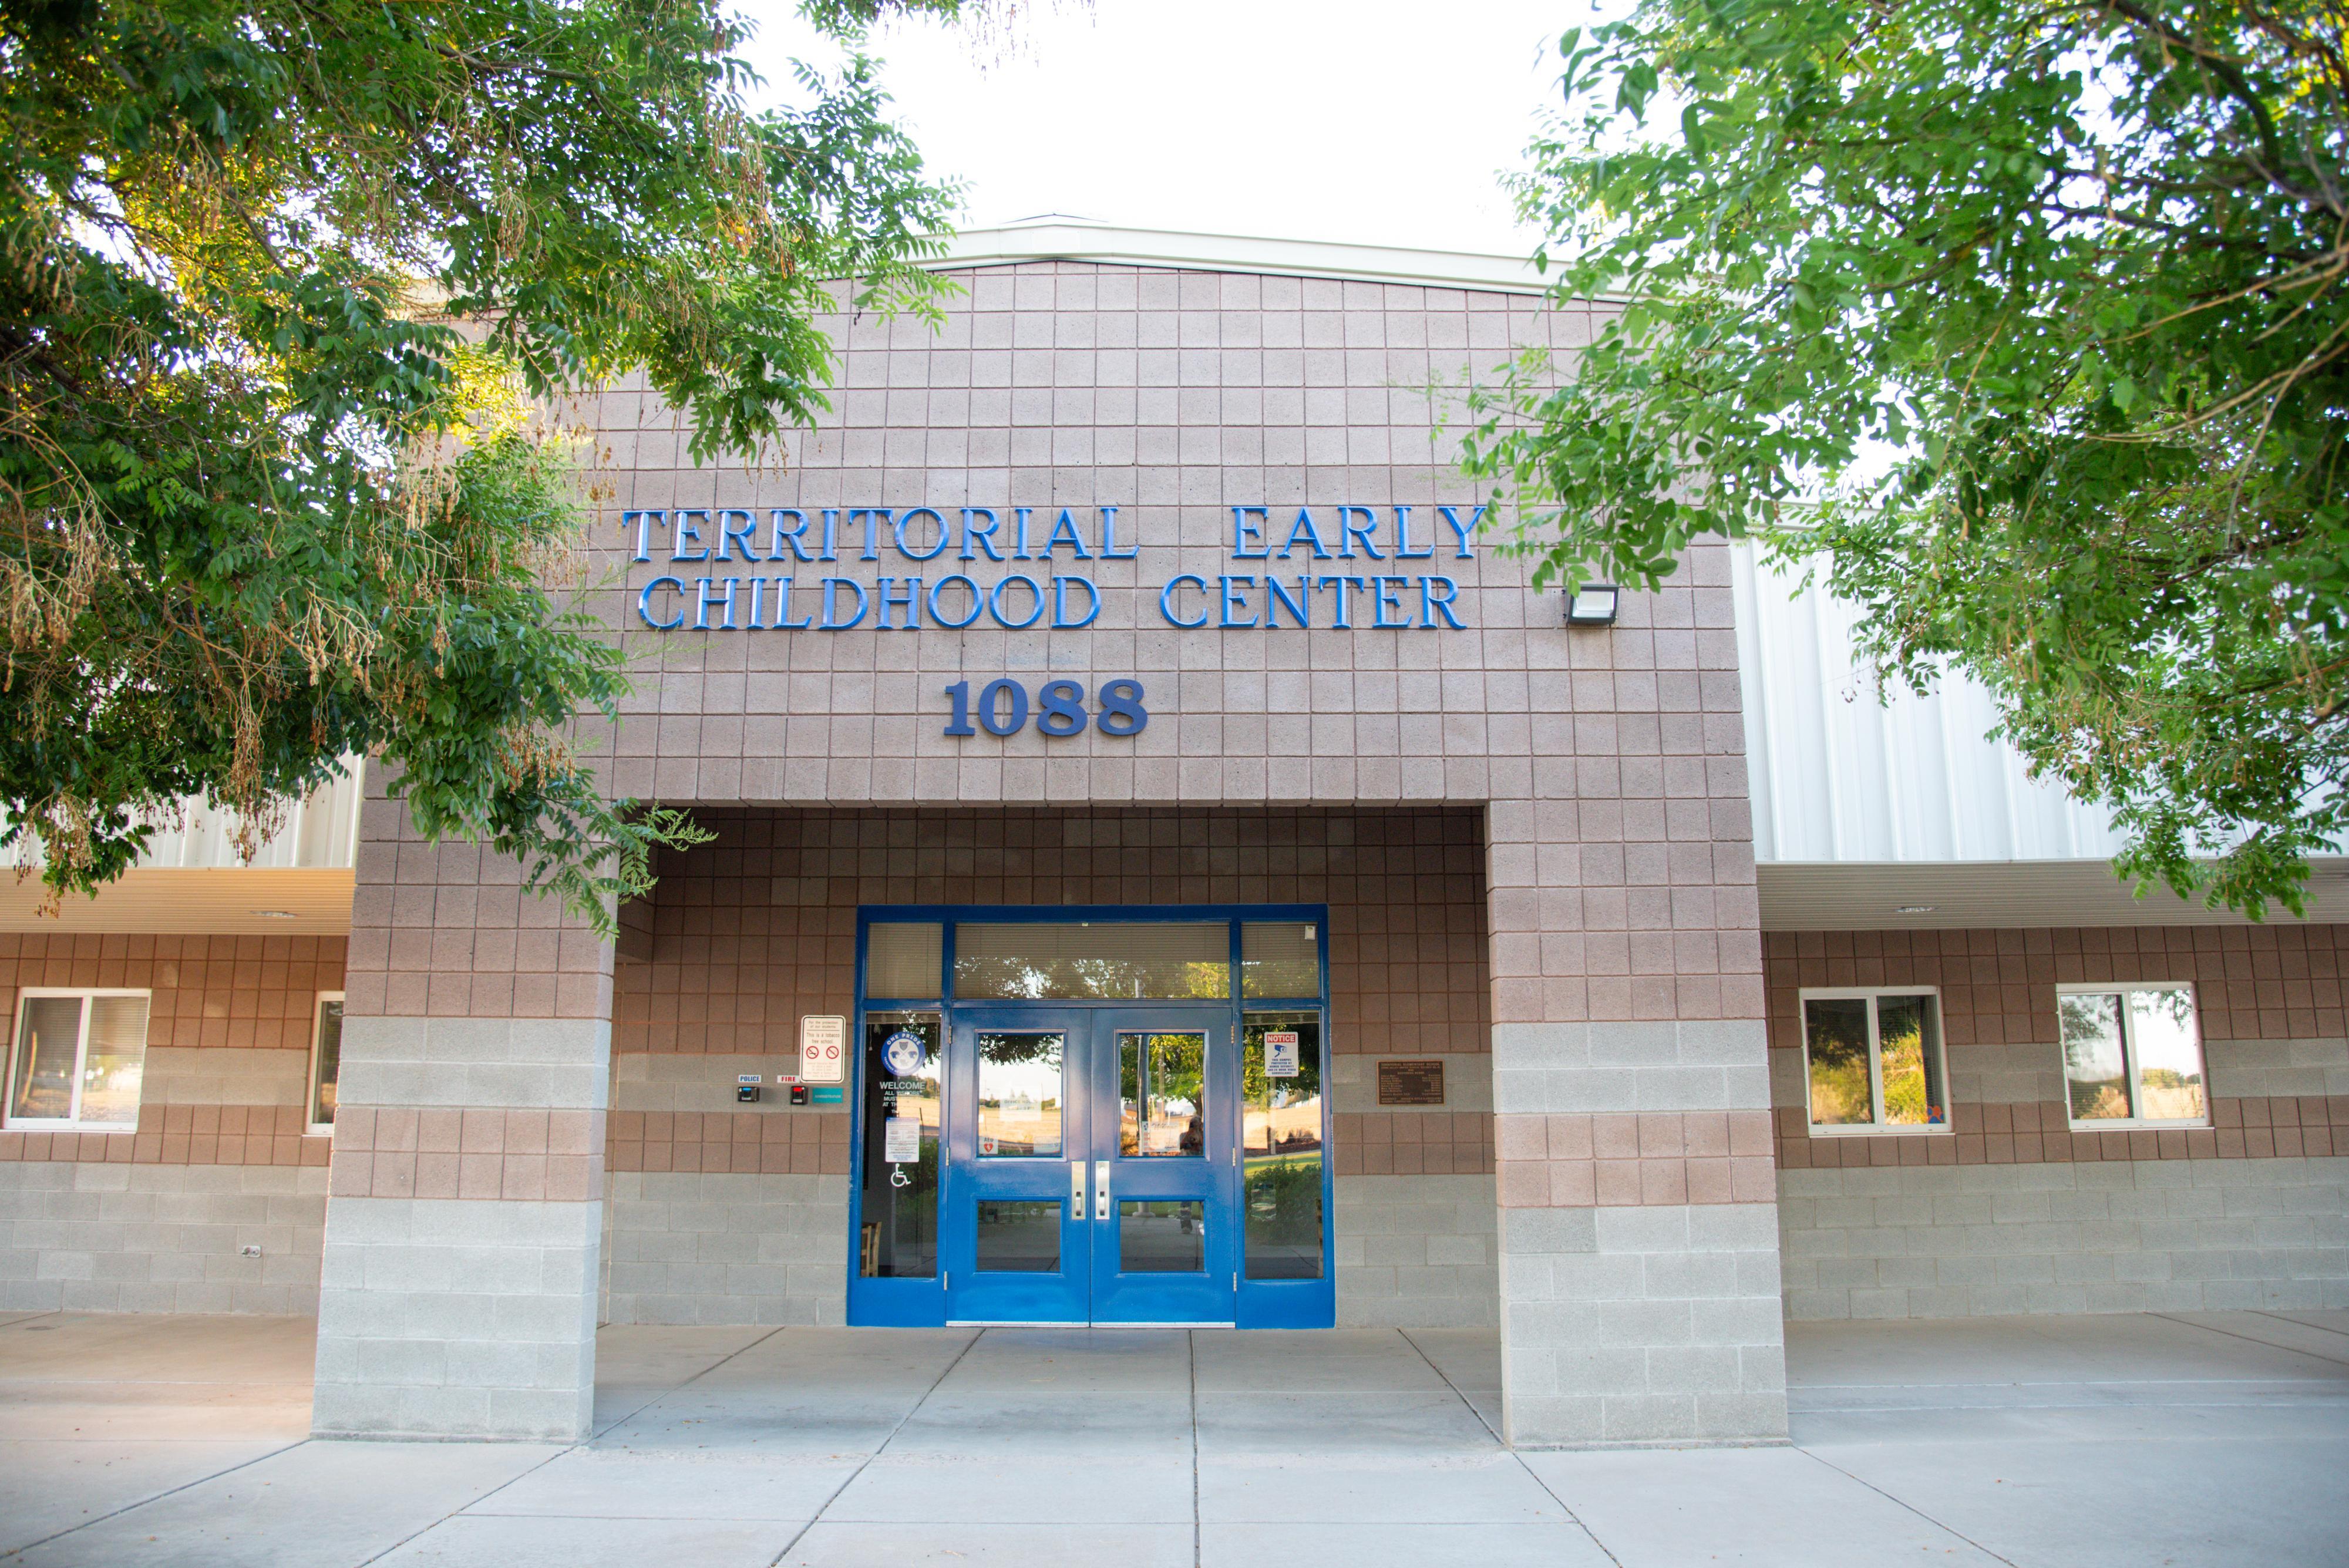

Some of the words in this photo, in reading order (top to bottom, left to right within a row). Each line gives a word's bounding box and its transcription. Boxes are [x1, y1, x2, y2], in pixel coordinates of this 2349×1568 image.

[622, 506, 1140, 562] TERRITORIAL
[1231, 506, 1488, 560] EARLY
[638, 574, 1102, 630] CHILDHOOD
[1159, 574, 1468, 630] CENTER
[944, 678, 1148, 736] 1088
[887, 1034, 899, 1045] ONE
[901, 1033, 921, 1045] PRIDE
[879, 1081, 926, 1089] WELCOME
